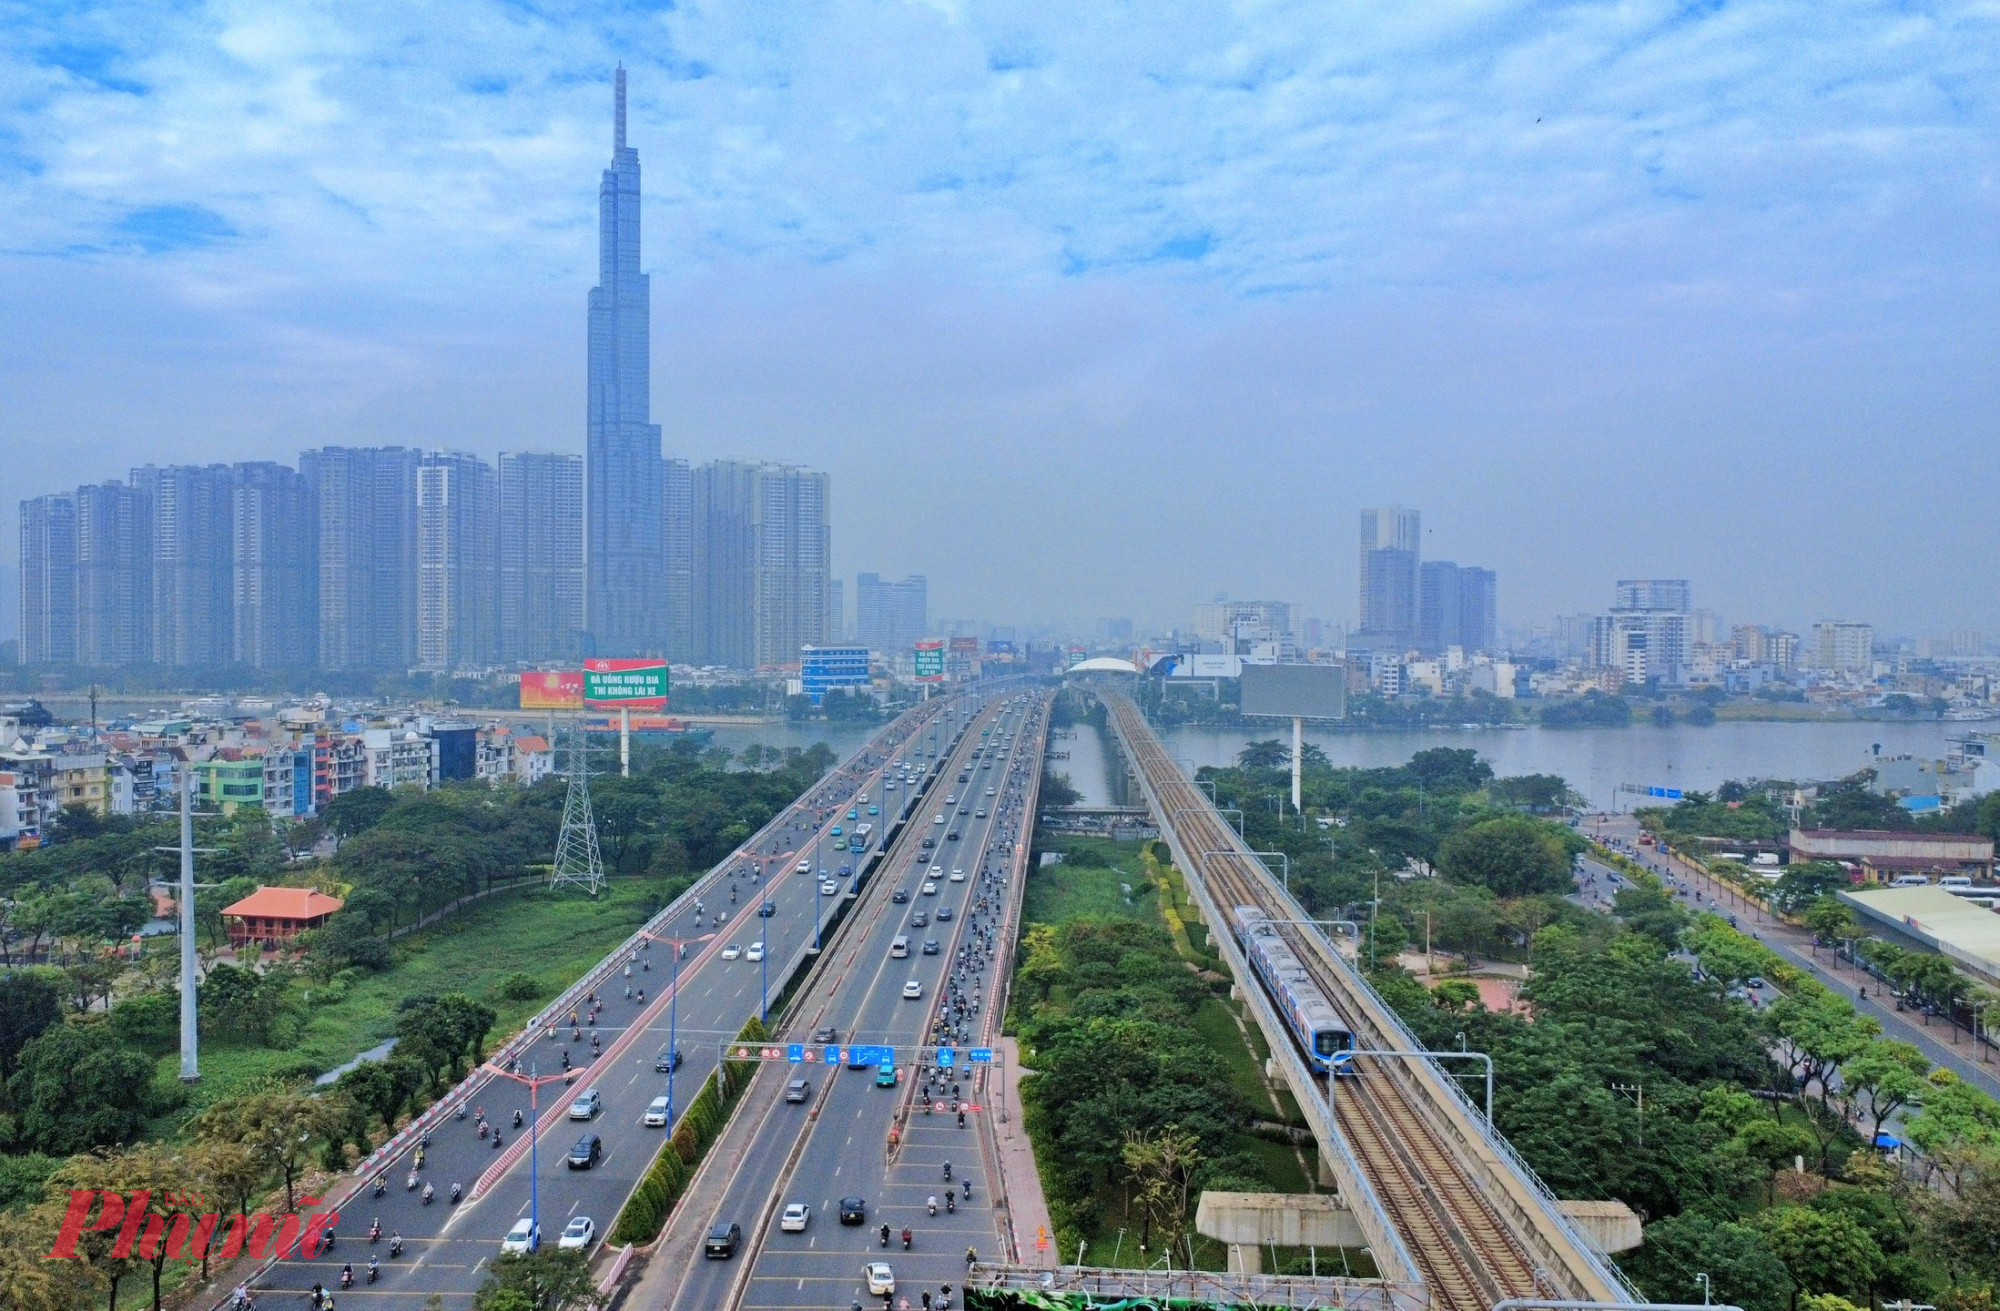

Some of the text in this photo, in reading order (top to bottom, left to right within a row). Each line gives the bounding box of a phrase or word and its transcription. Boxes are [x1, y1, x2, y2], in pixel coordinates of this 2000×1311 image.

[590, 673, 601, 684] ĐÃ
[602, 672, 622, 684] UỐNG
[646, 675, 659, 684] BIA
[594, 685, 656, 695] THÌ KHÔNG LÁI XE
